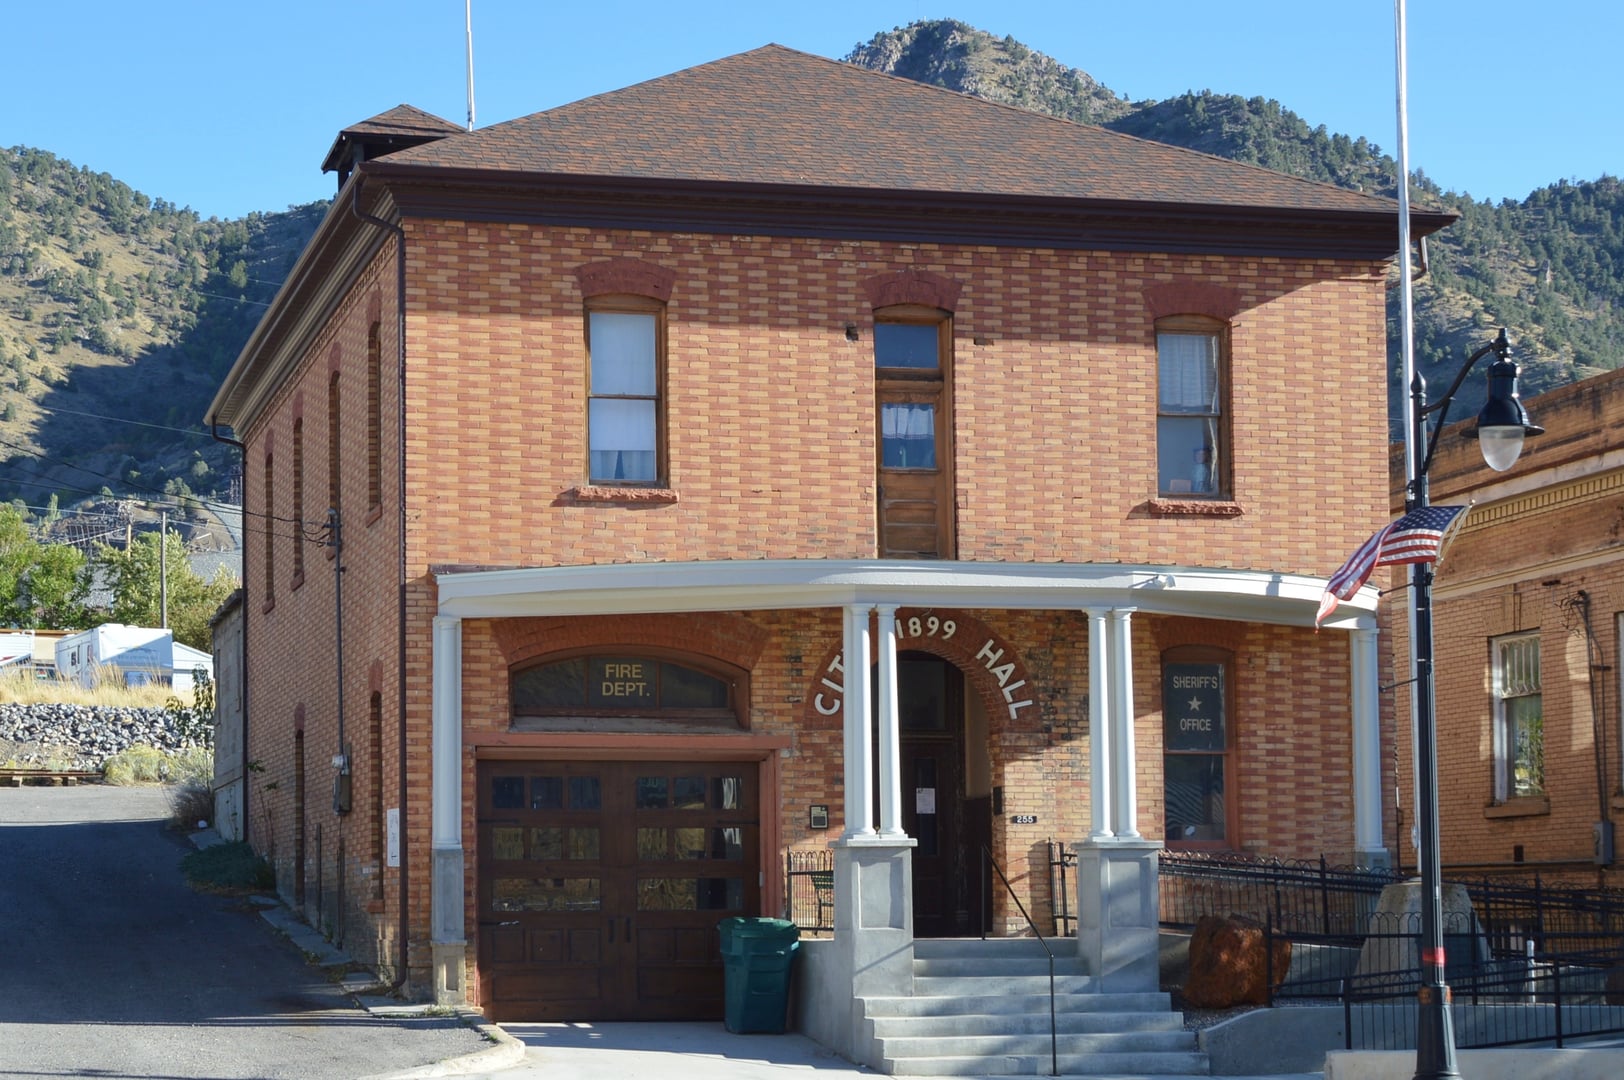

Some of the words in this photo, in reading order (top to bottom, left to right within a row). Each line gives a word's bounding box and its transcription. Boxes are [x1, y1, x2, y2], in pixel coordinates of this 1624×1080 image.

[605, 663, 643, 678] FIRE
[815, 648, 844, 715] CIT
[895, 616, 956, 640] 1899
[975, 639, 1033, 720] HALL
[602, 681, 650, 697] DEPT.
[1173, 675, 1218, 689] SHERIFF'S
[1180, 718, 1212, 731] OFFICE
[1016, 815, 1034, 823] 255
